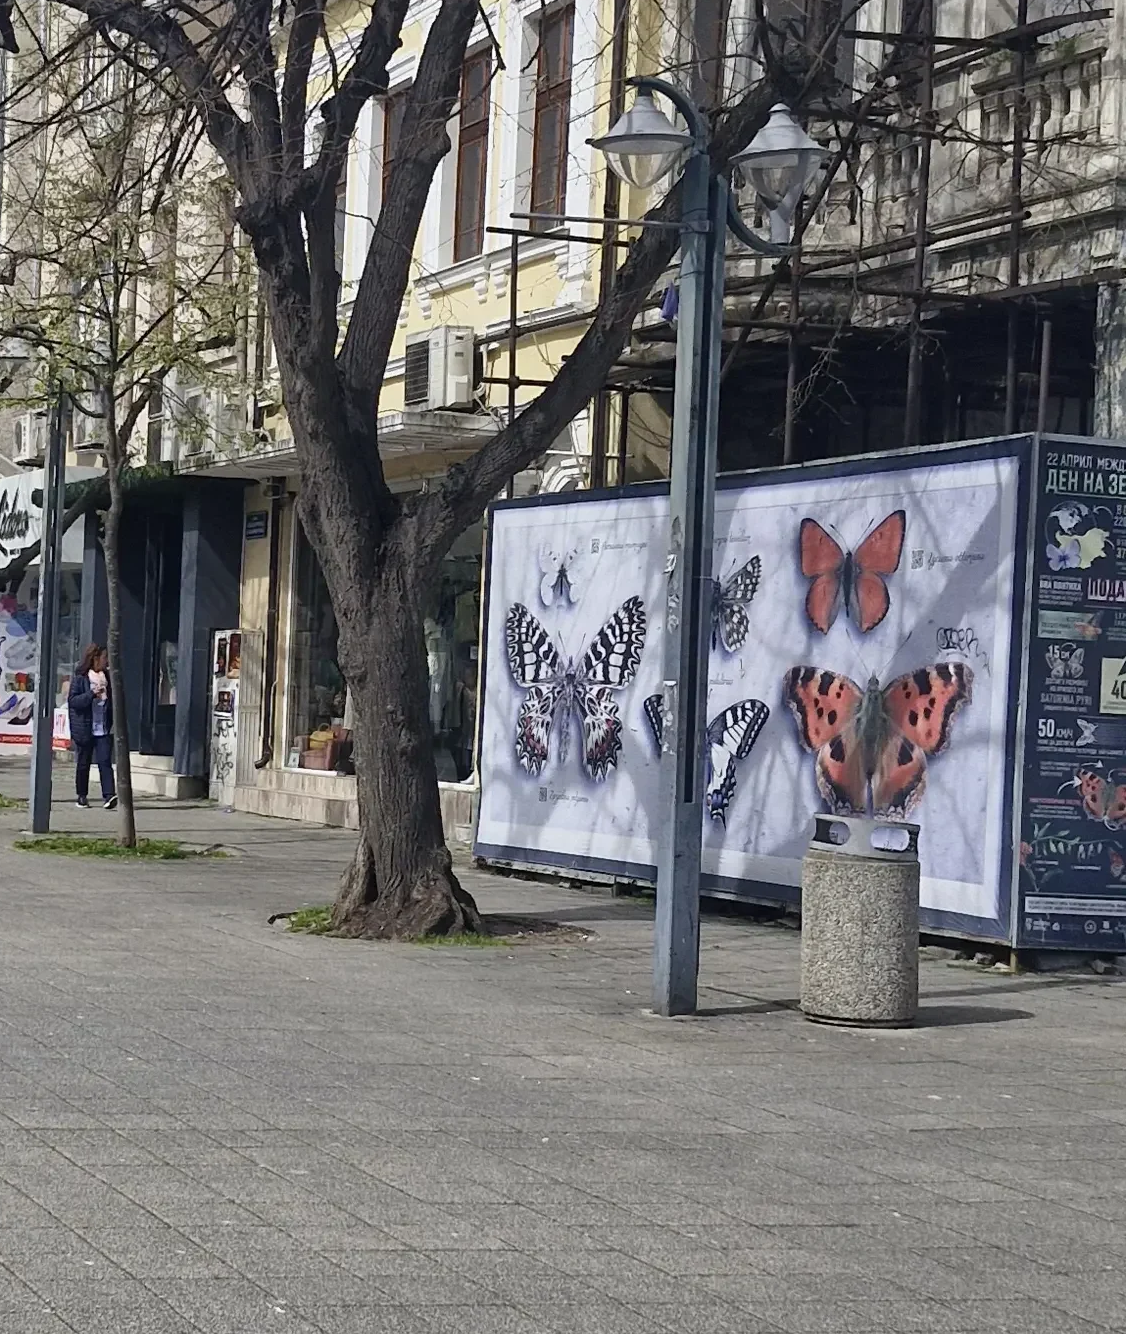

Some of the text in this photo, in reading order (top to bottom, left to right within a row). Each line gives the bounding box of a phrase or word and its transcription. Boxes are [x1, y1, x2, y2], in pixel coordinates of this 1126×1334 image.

[1047, 453, 1126, 472] 22 АПРИЛ МЕЖД
[1046, 469, 1078, 493] ДЕН
[1084, 472, 1104, 493] НА
[1048, 645, 1060, 658] 15
[1038, 718, 1055, 737] 50
